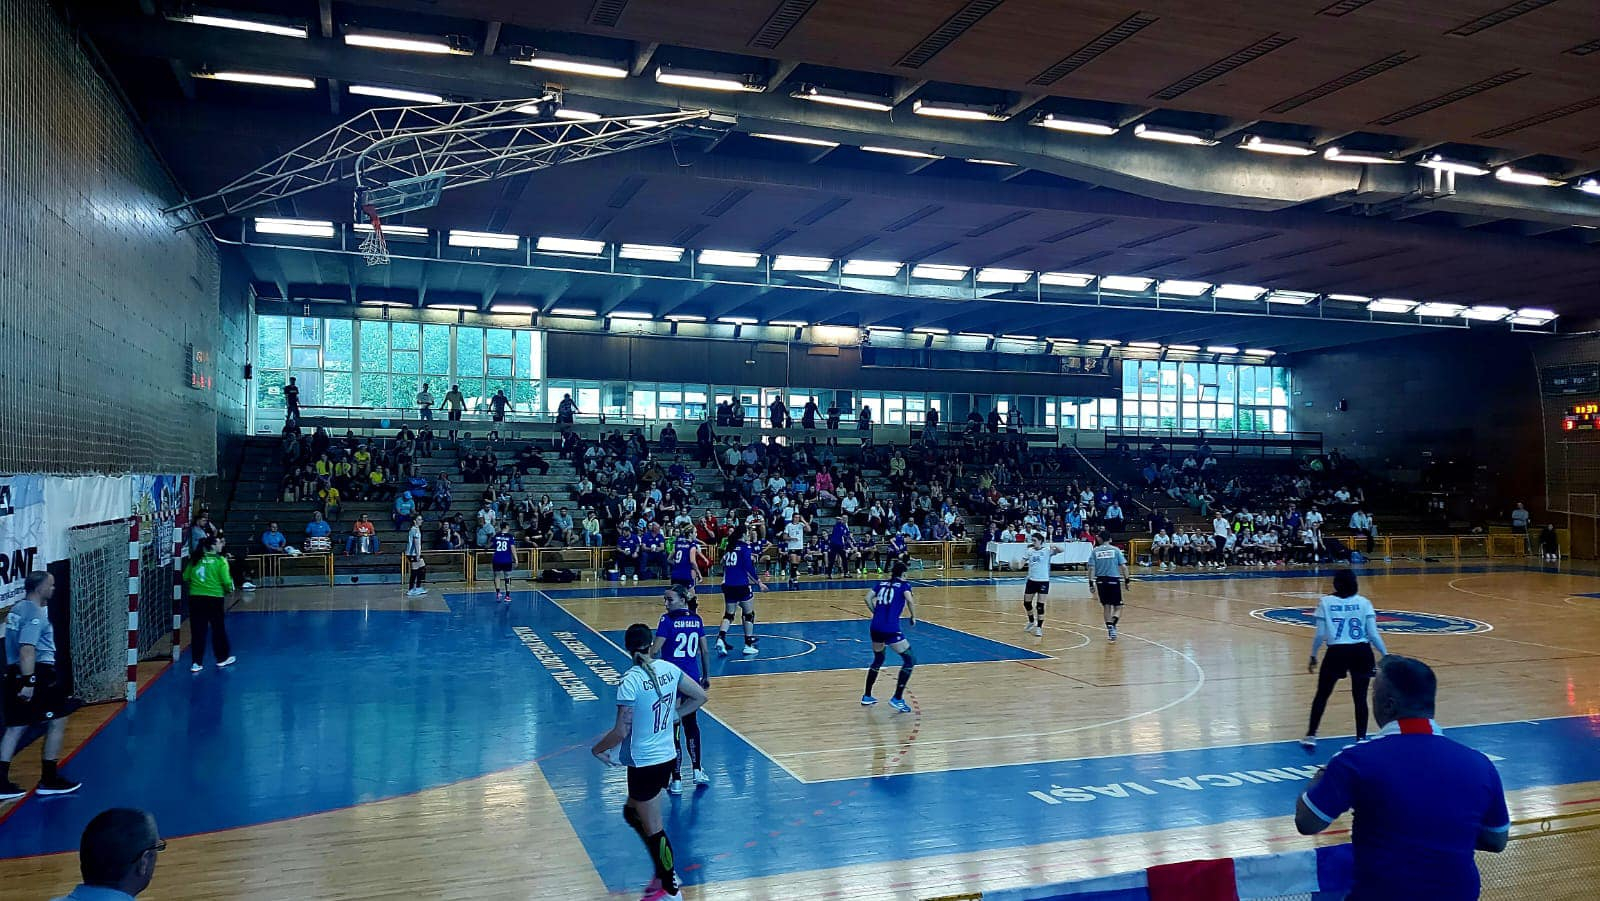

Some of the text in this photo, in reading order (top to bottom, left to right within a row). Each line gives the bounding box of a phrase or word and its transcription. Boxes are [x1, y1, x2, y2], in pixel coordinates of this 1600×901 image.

[496, 540, 508, 551] 28
[675, 550, 683, 564] 9
[725, 551, 738, 566] 29
[877, 586, 895, 604] 40
[1331, 617, 1362, 640] 78
[673, 631, 699, 658] 20
[658, 671, 674, 687] DEVA
[652, 691, 674, 734] 17
